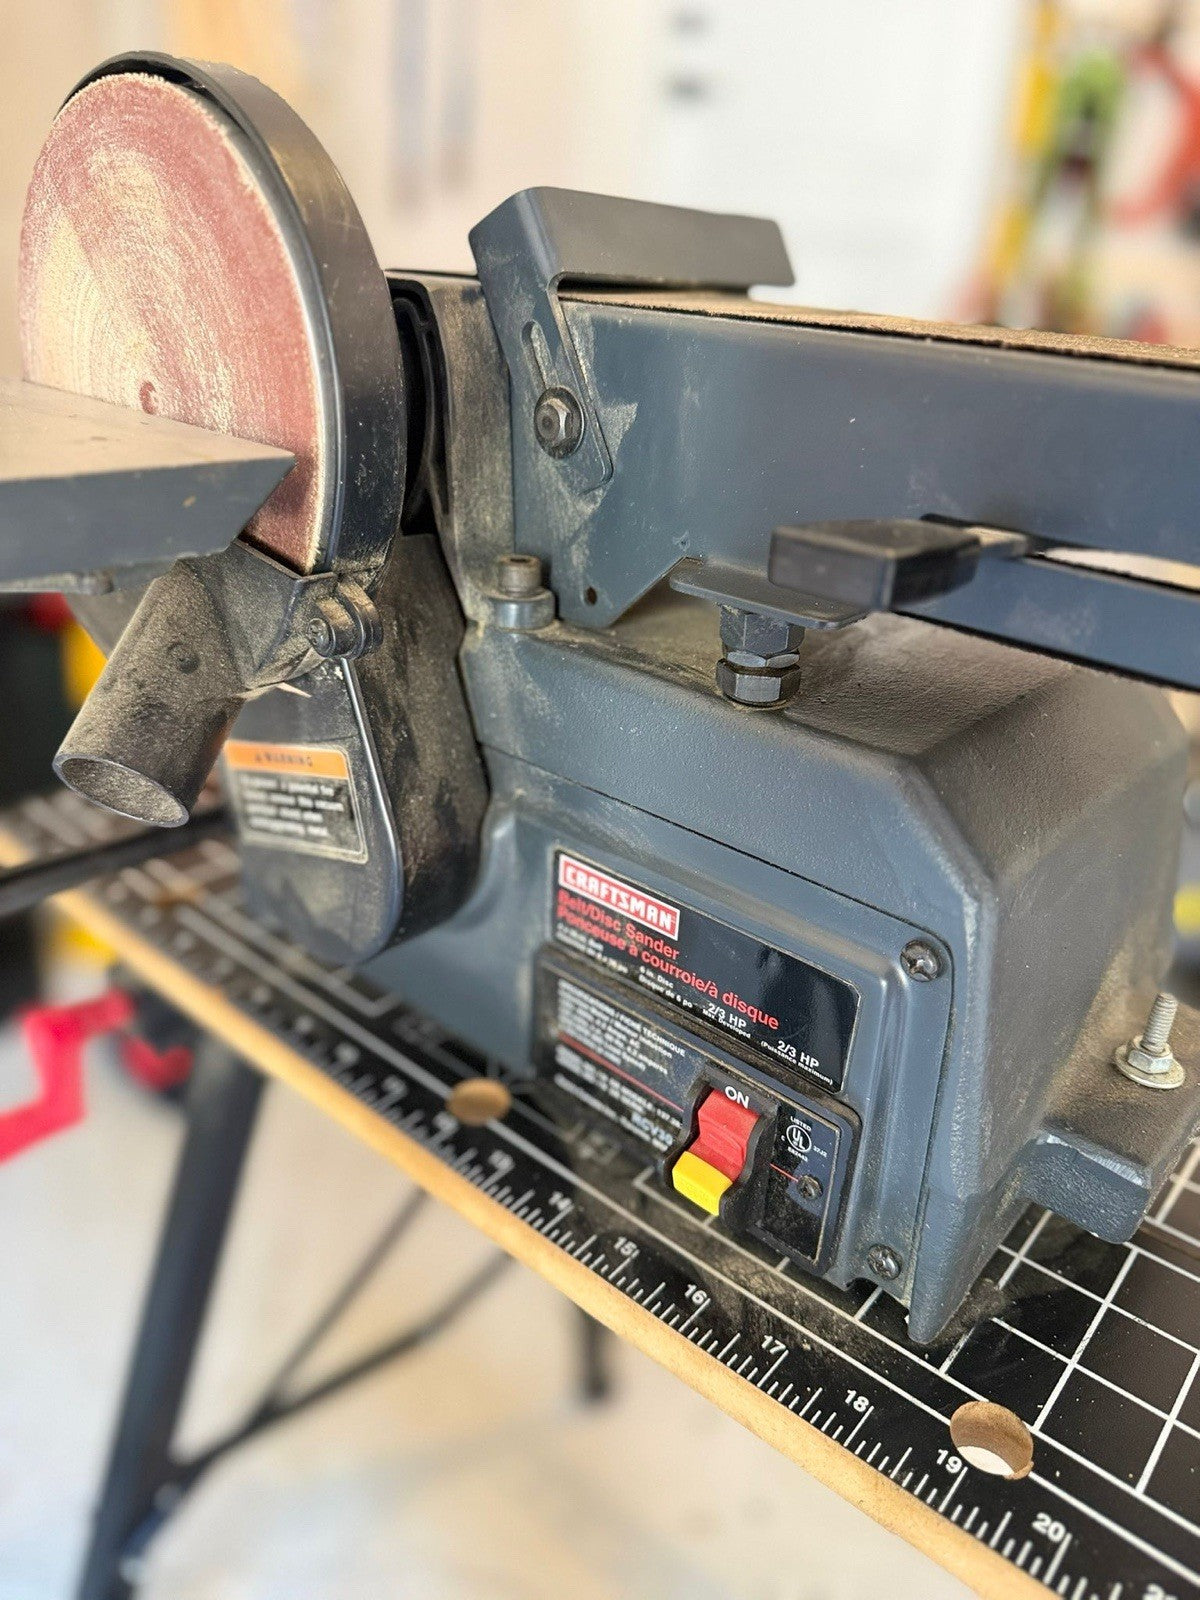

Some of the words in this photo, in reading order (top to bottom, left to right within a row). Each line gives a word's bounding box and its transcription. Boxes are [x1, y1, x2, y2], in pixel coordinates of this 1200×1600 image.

[564, 864, 673, 932] CRAFTSMAN
[557, 887, 622, 932] Belt/Disc
[625, 922, 680, 960] Sander
[557, 903, 626, 951] Ponceuse
[628, 941, 639, 958] à
[641, 949, 719, 999] courroie/à
[722, 991, 780, 1031] disque
[657, 975, 675, 989] Disc
[682, 999, 694, 1010] po
[708, 1003, 726, 1020] 2/3
[728, 1013, 748, 1030] HP
[718, 1017, 752, 1040] Developed
[642, 1026, 686, 1058] TECHNIQUE
[760, 1041, 798, 1066] (Puissance
[797, 1061, 834, 1086] maximum)
[777, 1040, 797, 1058] 2/3
[799, 1052, 821, 1069] HP
[724, 1085, 750, 1109] ON
[790, 1115, 812, 1132] LISTED
[792, 1127, 807, 1151] UL
[613, 1236, 638, 1256] 15
[684, 1283, 708, 1306] 16
[761, 1335, 787, 1355] 17
[844, 1388, 870, 1413] 18
[936, 1448, 963, 1474] 19
[1031, 1511, 1066, 1543] 20
[1142, 1582, 1179, 1600] 2
